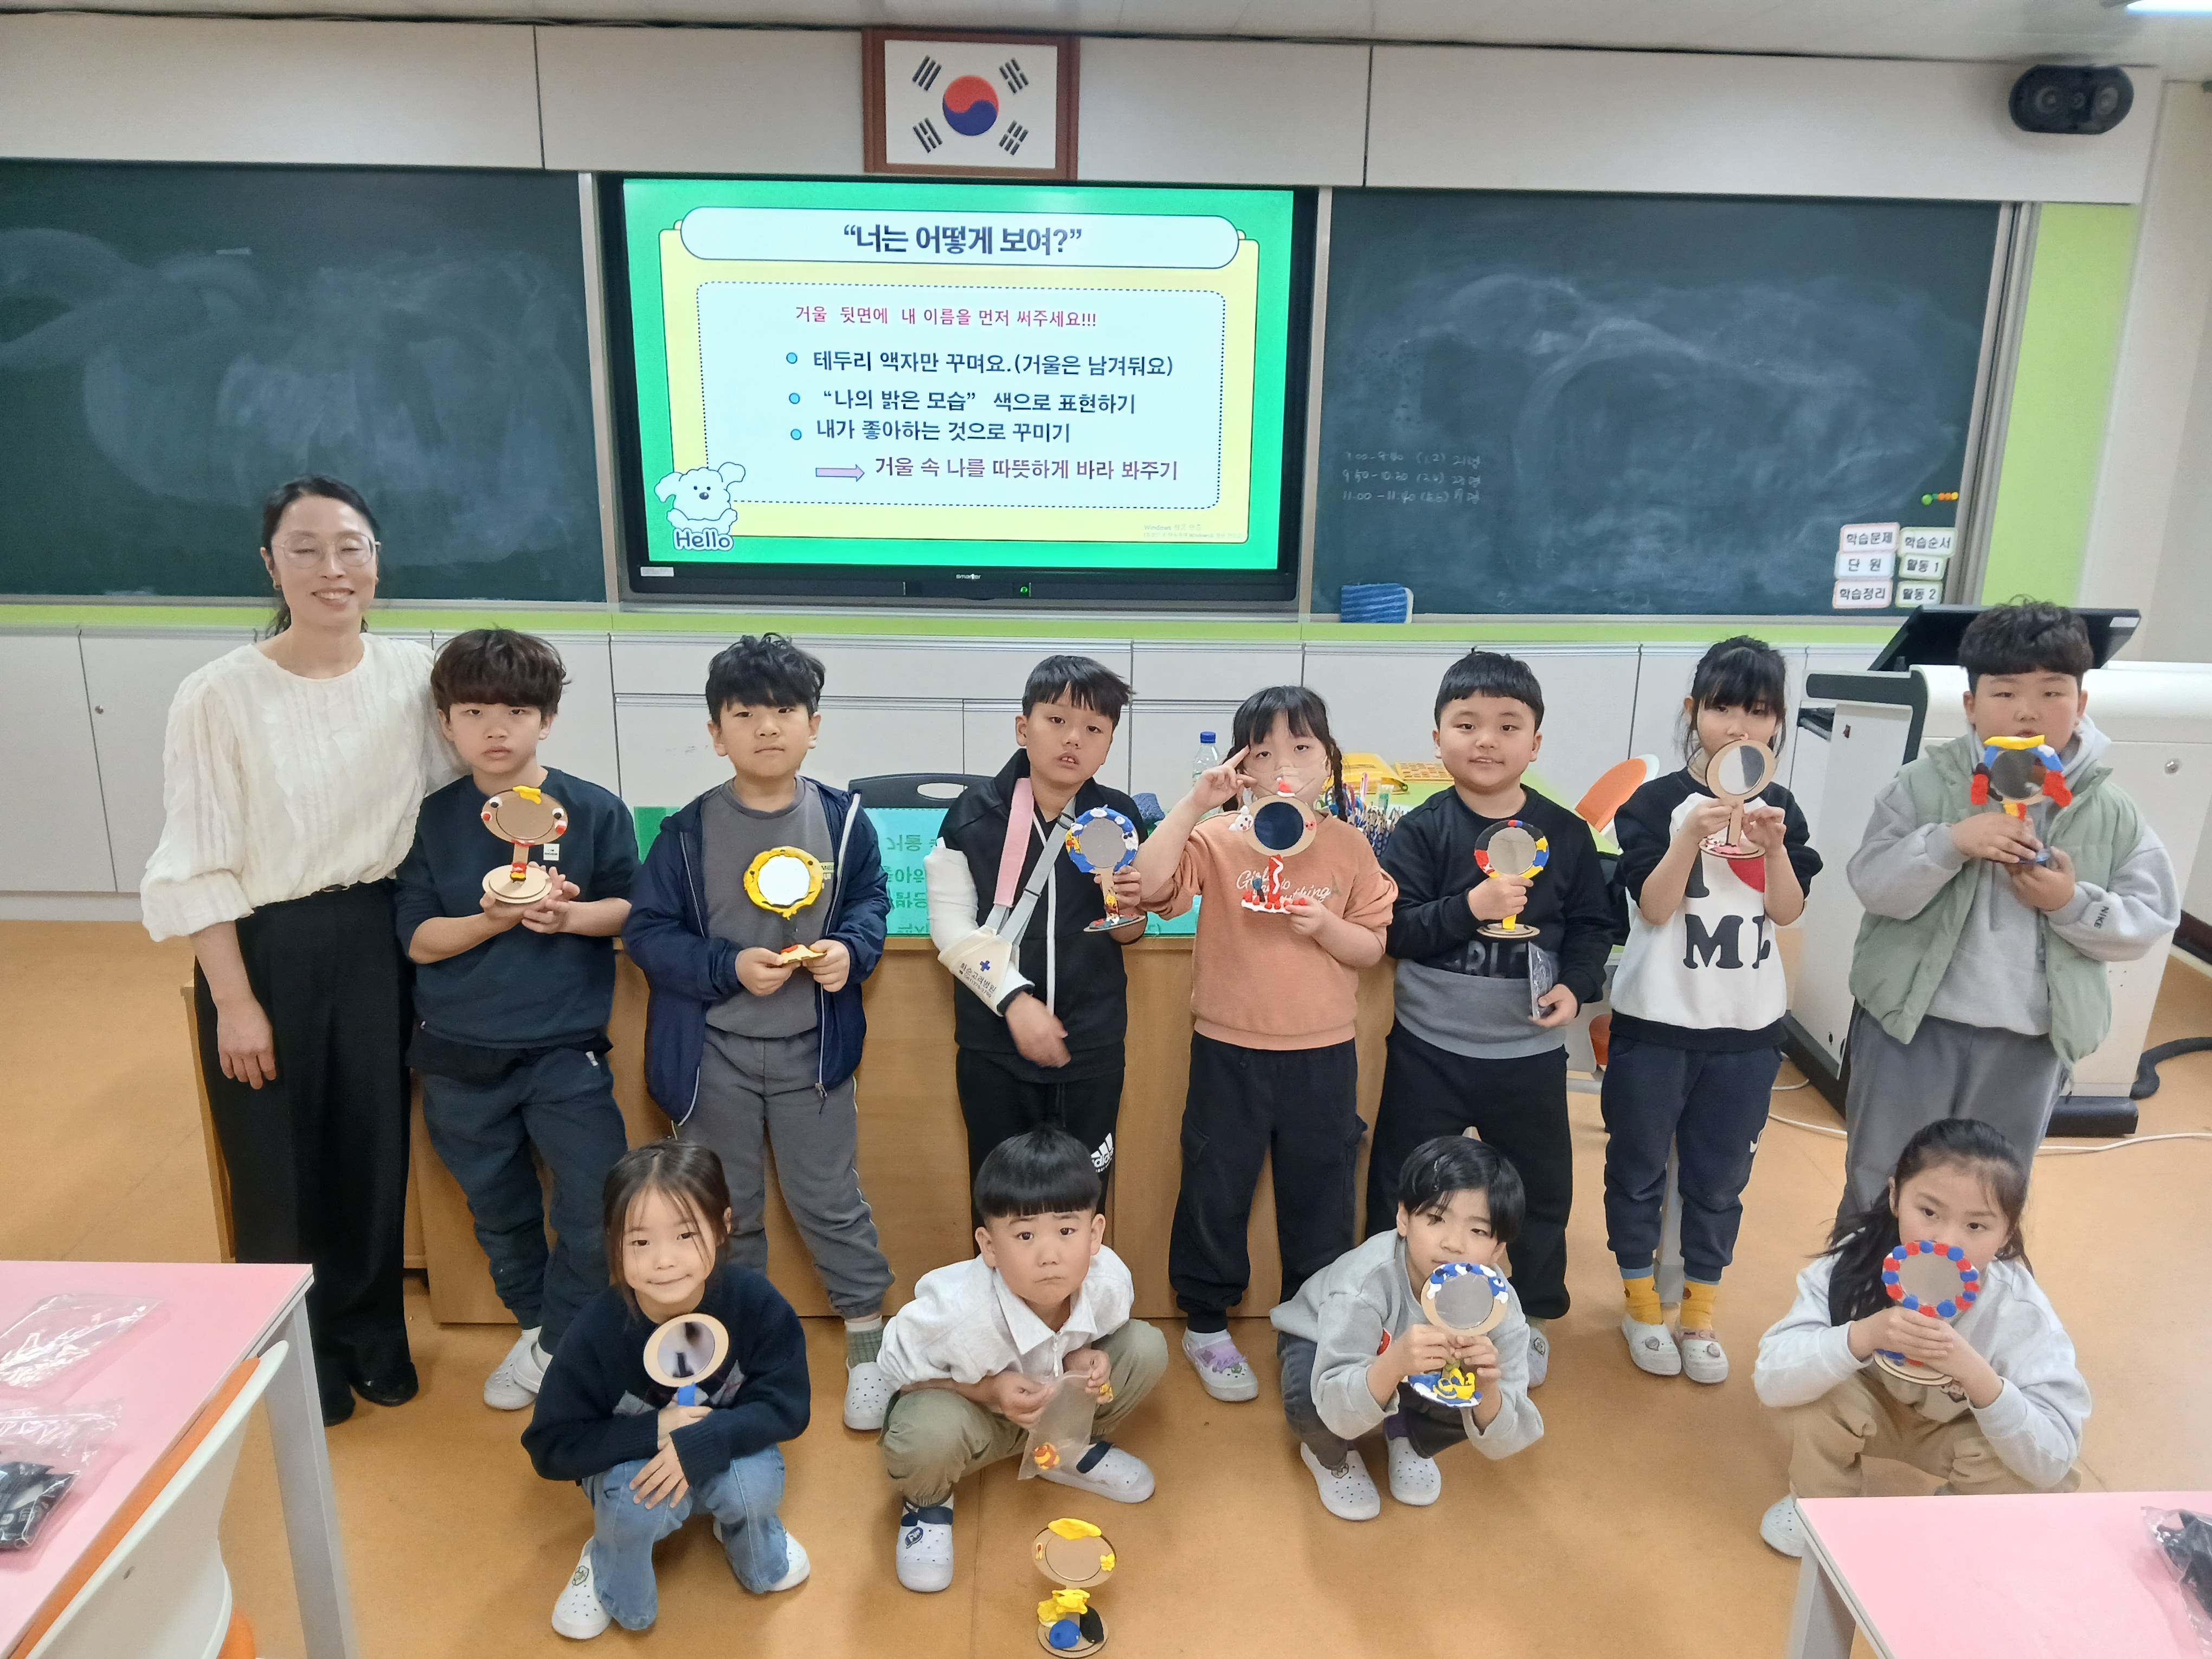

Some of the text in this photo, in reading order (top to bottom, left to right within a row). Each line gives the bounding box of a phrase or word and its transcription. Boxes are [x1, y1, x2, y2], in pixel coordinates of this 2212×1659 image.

[916, 225, 993, 255] 어떻게
[796, 306, 1096, 327] 거울 뒷면에 내 이름을 먼저 써주세요!!!
[813, 350, 871, 372] 테두리
[880, 351, 939, 372] 액자만
[1088, 355, 1173, 376] 남겨둬요)
[882, 390, 920, 410] 밝은
[993, 392, 1051, 413] 색으로
[1058, 394, 1135, 415] 표현하기
[816, 419, 1070, 443] 내가 좋아하는 것으로 꾸미기
[875, 456, 1177, 481] 거울 속 나를 따뜻하게 바라 봐주기
[676, 531, 730, 548] Hello
[1846, 531, 1893, 545] 학습문제
[1905, 536, 1951, 549] 학습순서
[1907, 558, 1939, 573] 활동 1
[1840, 587, 1886, 601] 학습정리
[1902, 588, 1936, 601] 활동 2
[2094, 906, 2109, 929] NIKE
